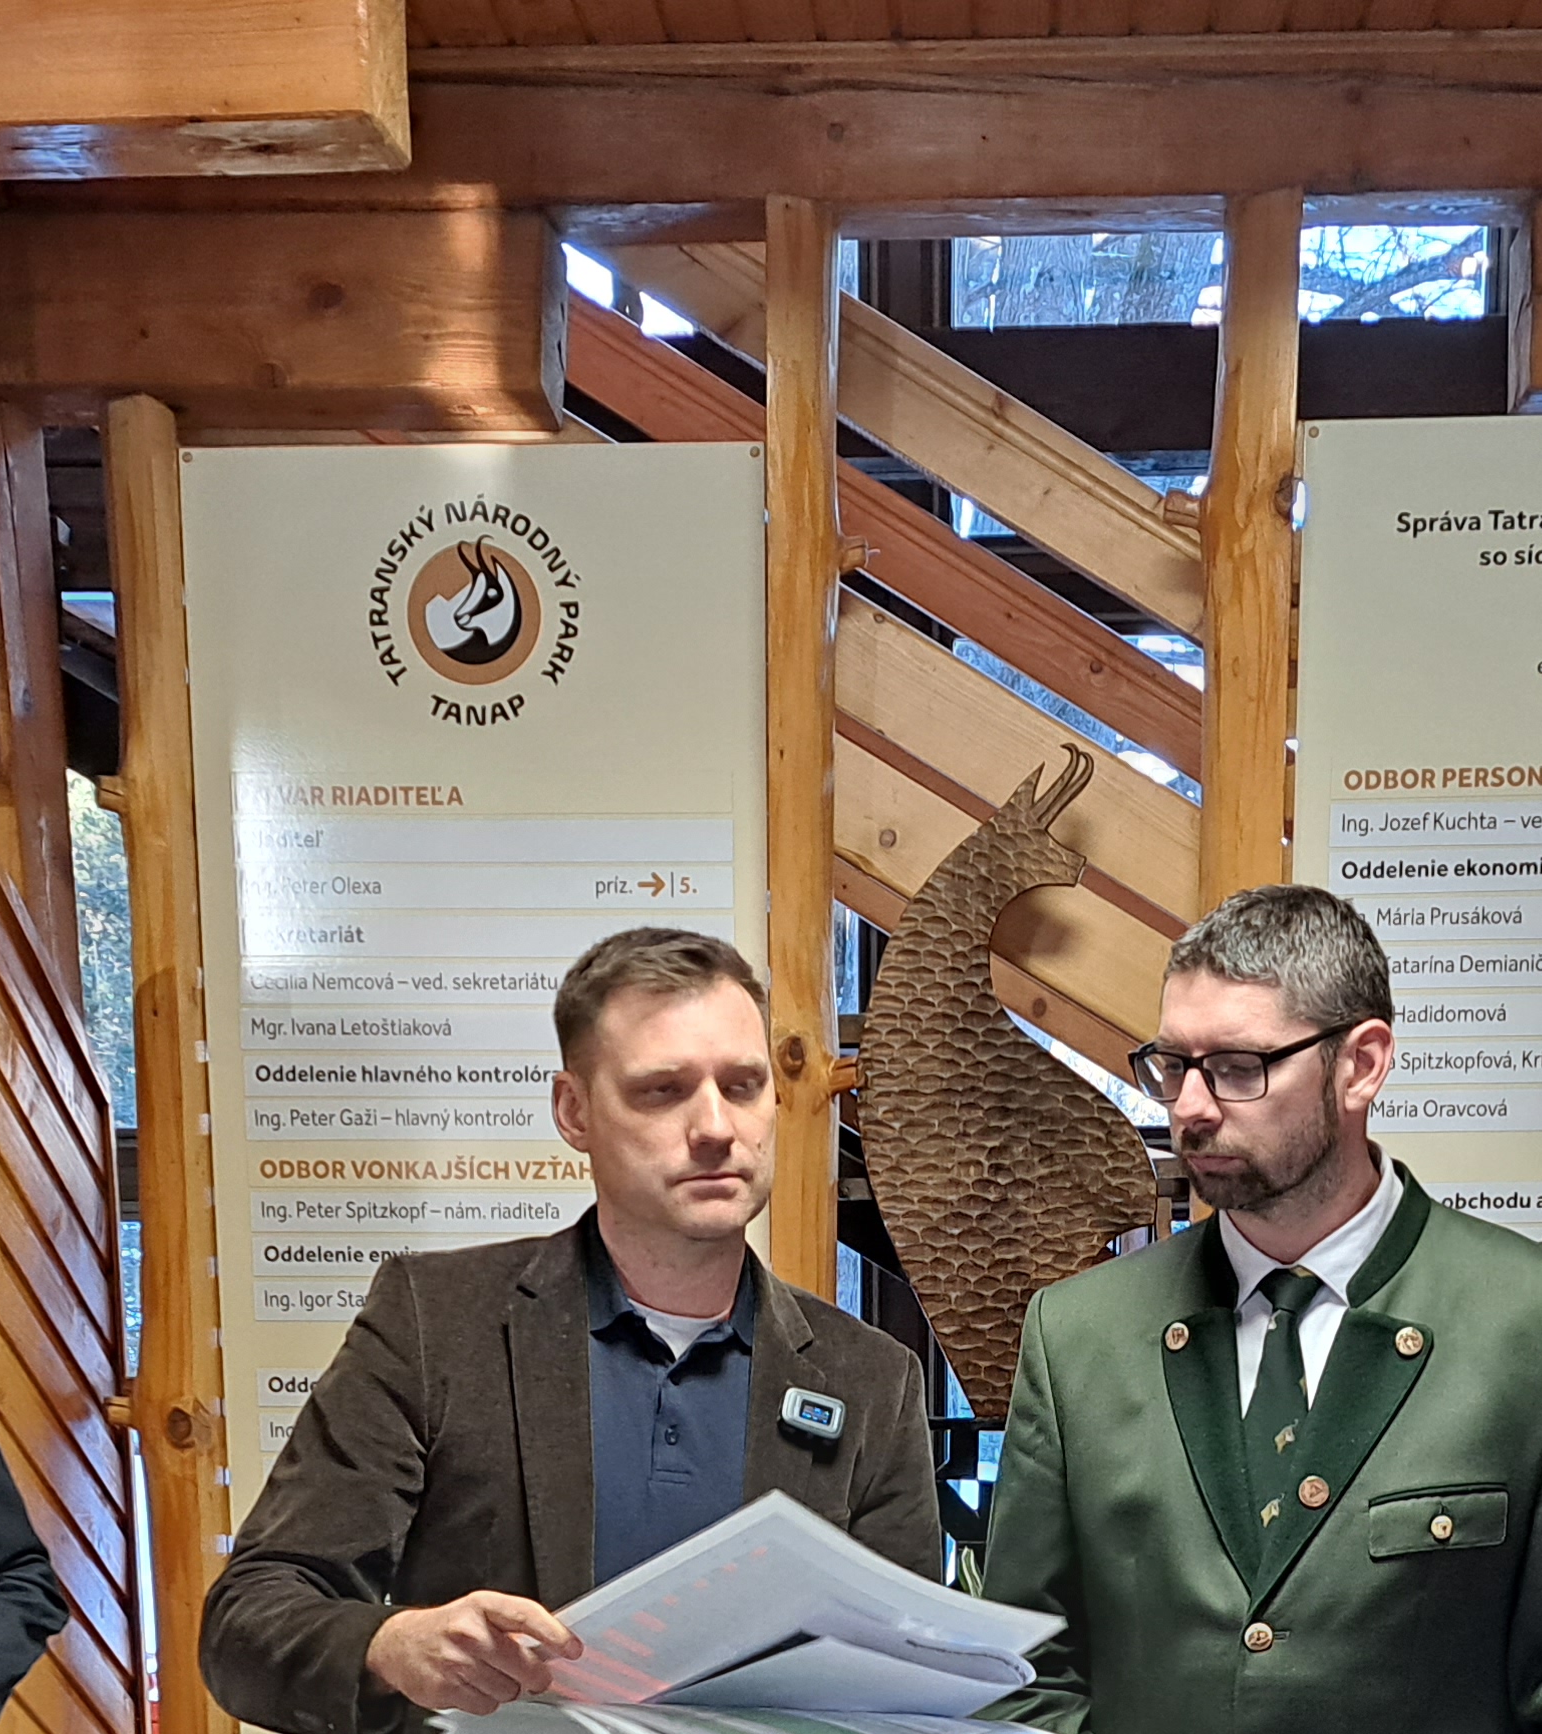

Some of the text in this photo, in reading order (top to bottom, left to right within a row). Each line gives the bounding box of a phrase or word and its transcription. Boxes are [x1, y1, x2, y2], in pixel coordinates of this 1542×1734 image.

[1396, 511, 1481, 537] Správa
[1479, 548, 1507, 567] so
[369, 493, 582, 685] TATRANSKÝ NÁRODNÝ PARK
[429, 694, 526, 725] TANAP
[1344, 769, 1435, 791] ODBOR
[332, 786, 464, 806] RIADITEĽA
[1341, 814, 1374, 836] Ing.
[1378, 812, 1429, 833] Jozef
[1433, 811, 1497, 832] Kuchta
[1341, 859, 1448, 880] Oddelenie
[332, 876, 381, 894] Olexa
[595, 875, 698, 899] príz. 5.
[1377, 905, 1522, 926] Mária Prusáková
[312, 972, 558, 990] Nemcová ved. sekretariátu
[1393, 1003, 1507, 1023] Hadidomová
[251, 1018, 452, 1040] Mgr. Ivana Letoštiaková
[1400, 1052, 1517, 1074] Spitzkopfová,
[255, 1065, 452, 1083] Oddelenie hlavného
[1370, 1099, 1507, 1117] Mária Oravcová
[254, 1108, 534, 1132] Ing. Peter Gaži hlavný kontrolór
[259, 1155, 510, 1179] ODBOR VONKAJŠÍCH
[1442, 1192, 1530, 1209] obchodu
[261, 1201, 560, 1222] Ing. Peter Spitzkopf nám. riaditeľa
[264, 1246, 364, 1262] Oddelenie
[264, 1291, 332, 1311] Ing. Igor
